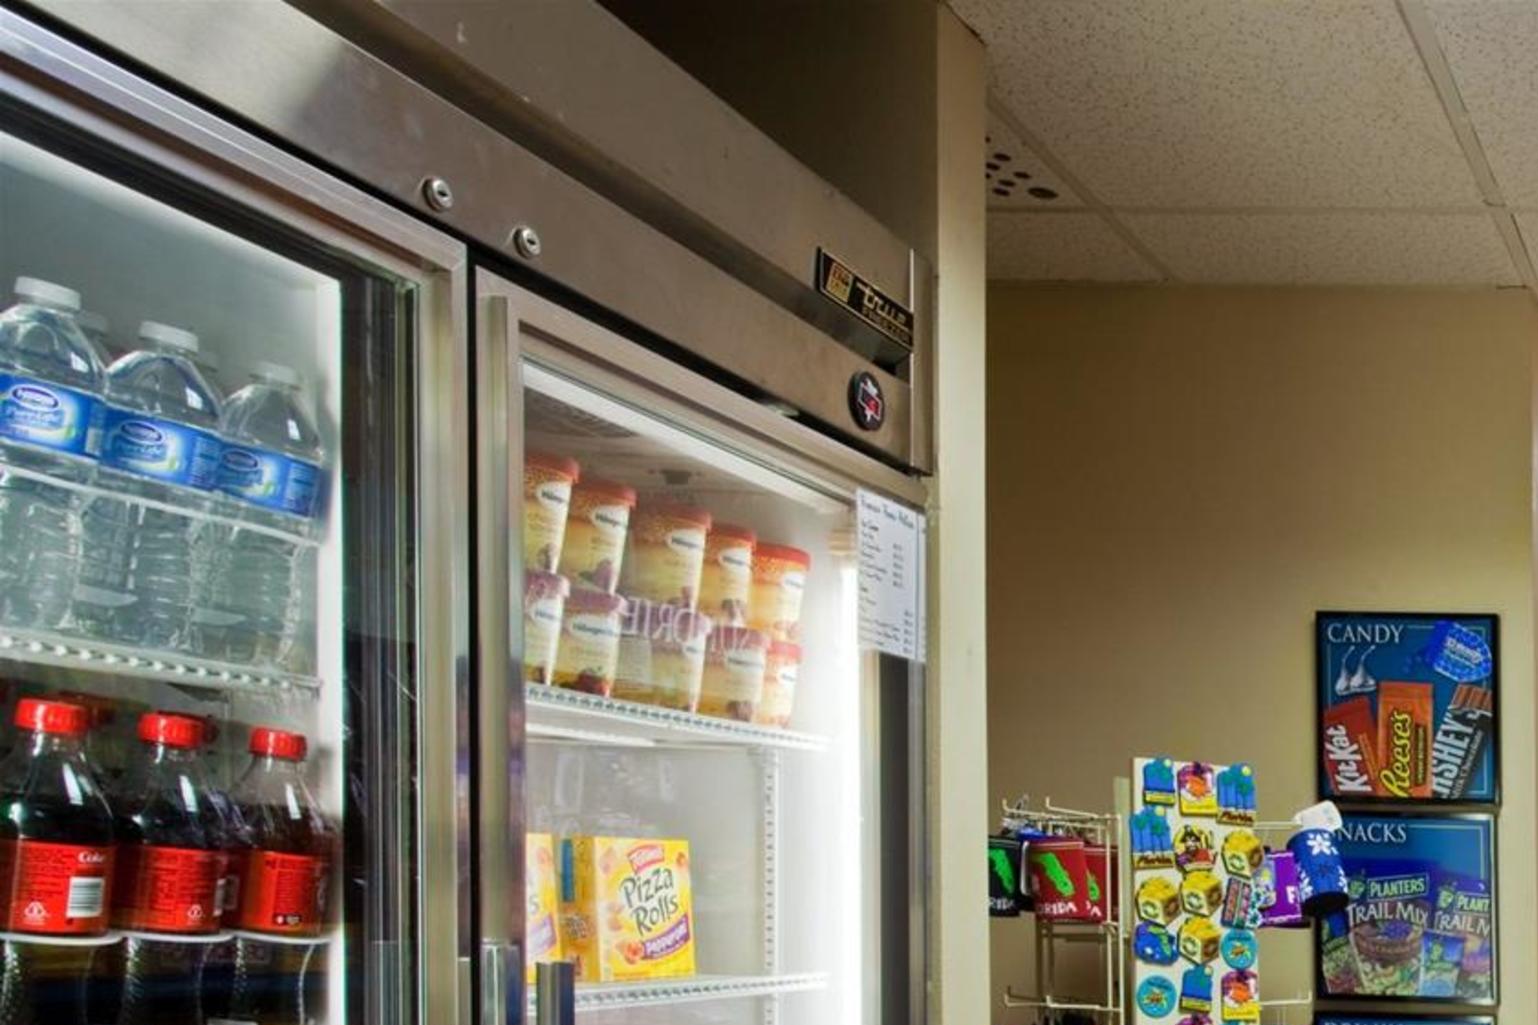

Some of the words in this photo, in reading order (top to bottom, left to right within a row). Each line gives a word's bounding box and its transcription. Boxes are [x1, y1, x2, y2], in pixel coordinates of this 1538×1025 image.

[1327, 623, 1404, 643] CANDY
[1334, 822, 1407, 843] NACKS
[620, 868, 674, 910] Pizza
[1370, 878, 1425, 897] PLANTERS
[632, 894, 679, 936] Rolls
[1346, 902, 1395, 926] TRAIL
